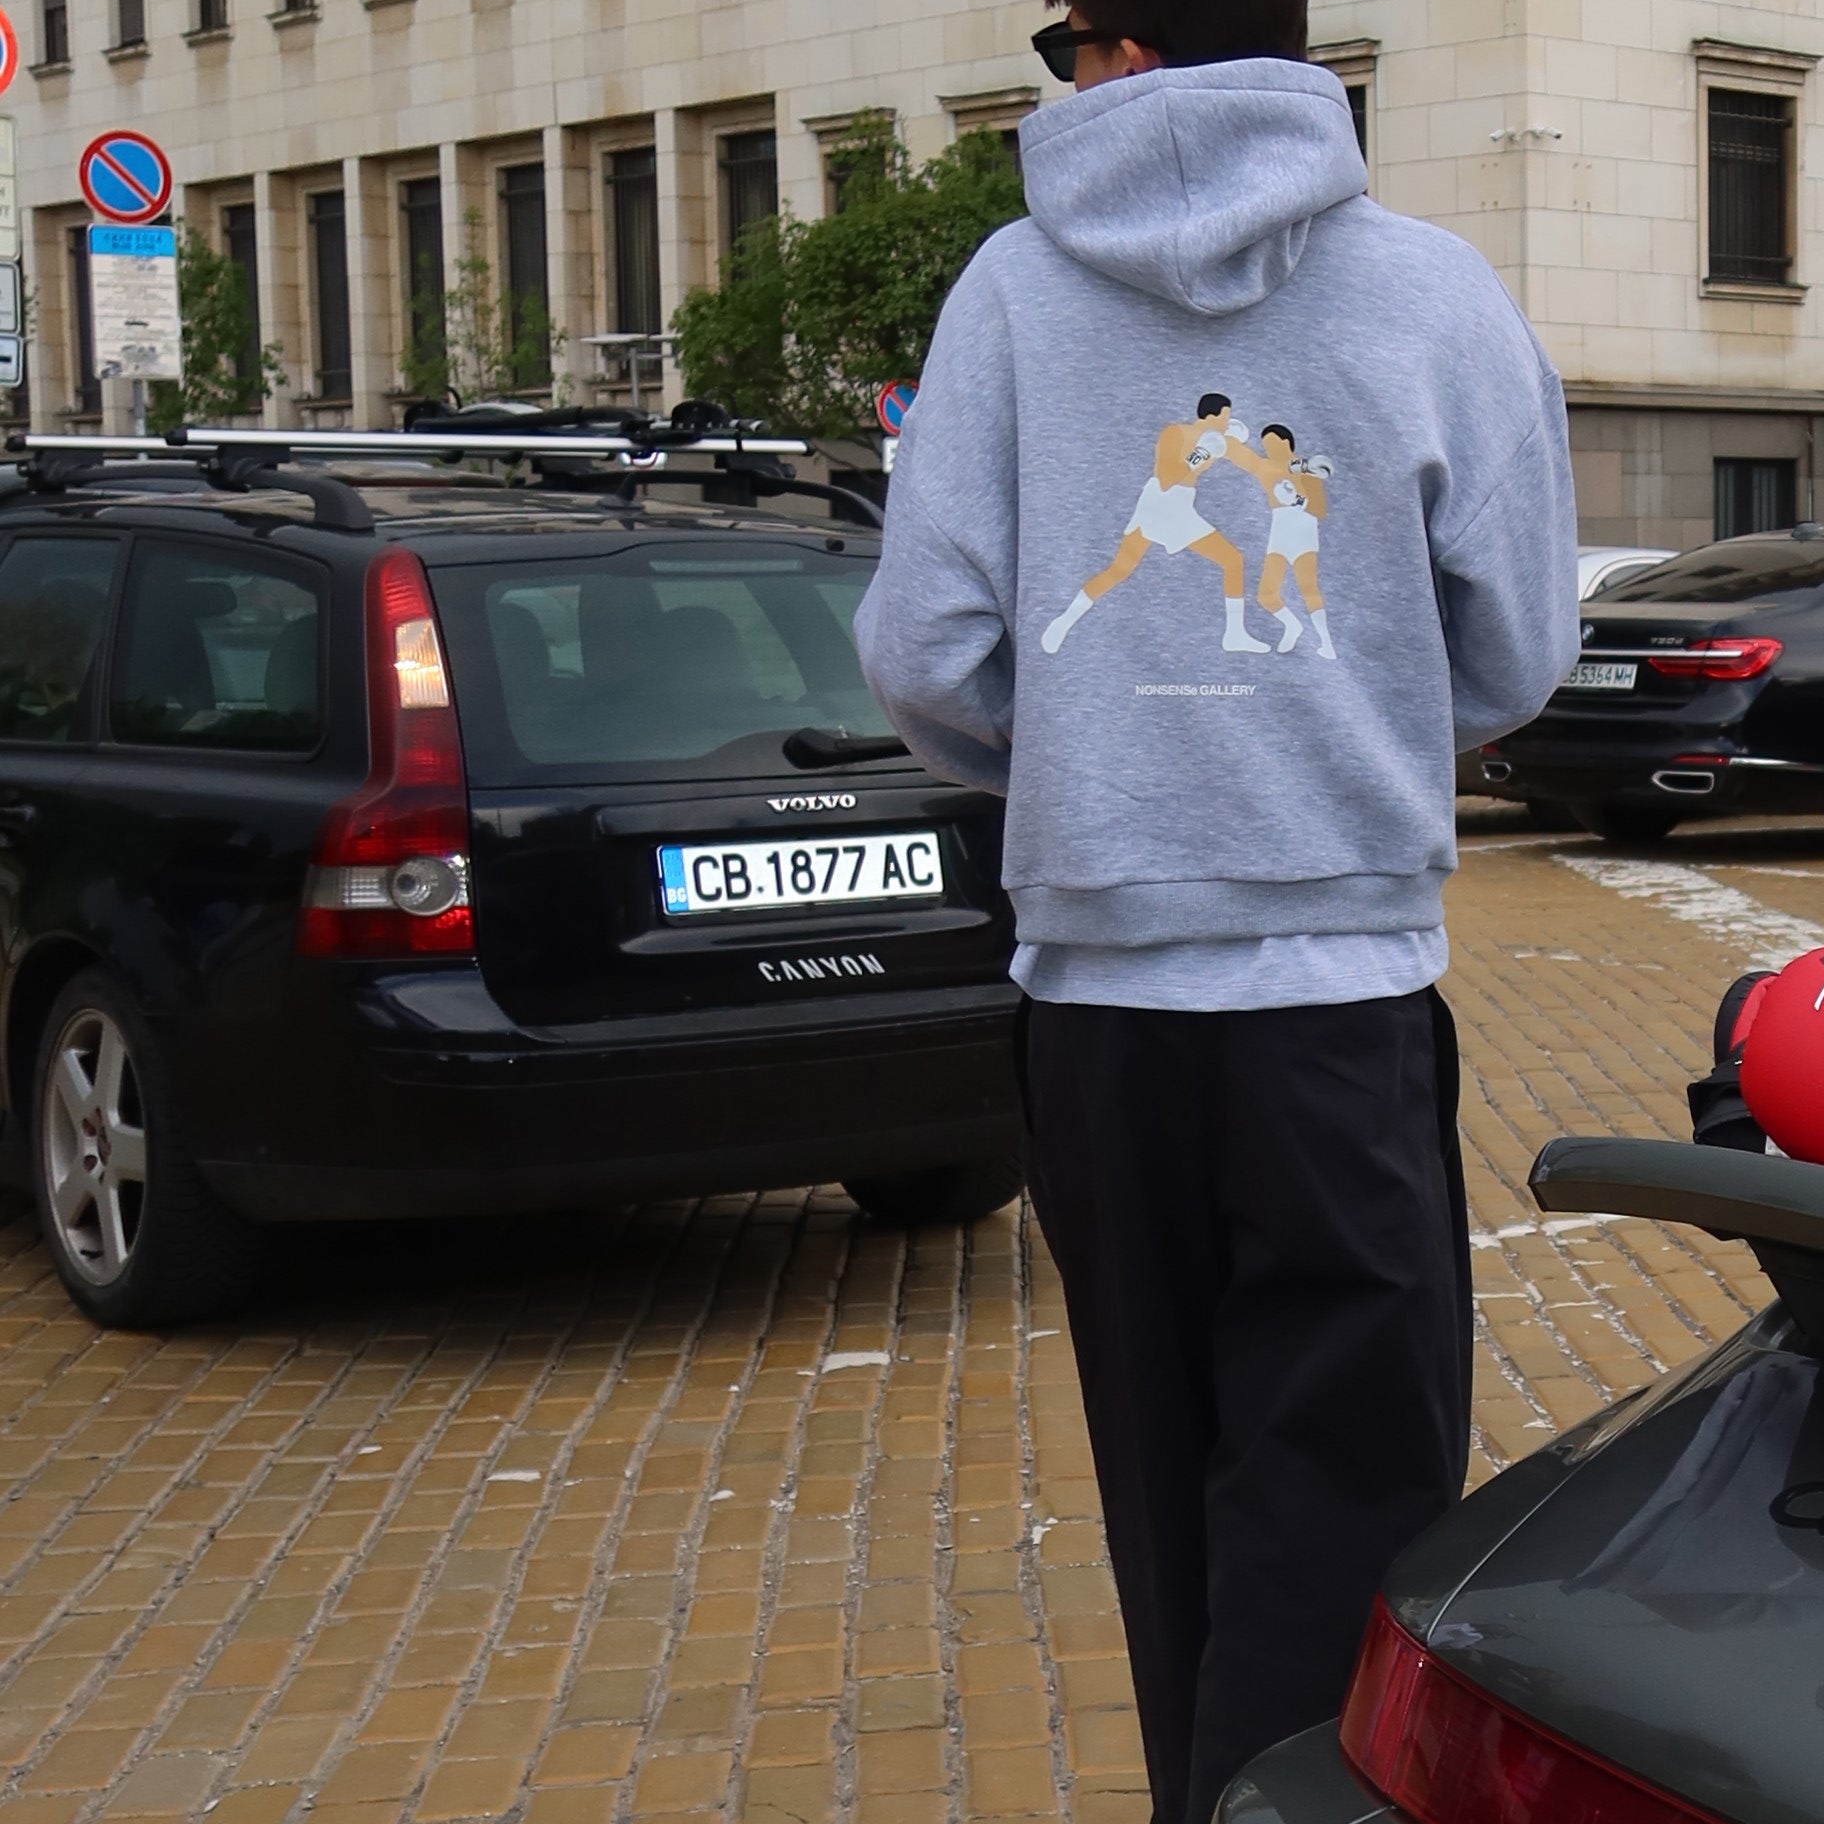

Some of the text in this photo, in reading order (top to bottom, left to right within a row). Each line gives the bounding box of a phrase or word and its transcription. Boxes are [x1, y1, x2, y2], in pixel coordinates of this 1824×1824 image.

[1200, 684, 1257, 696] GALLERY
[767, 794, 857, 813] VOLVO
[692, 842, 934, 902] CB 1877 AC
[667, 888, 687, 903] BG
[758, 953, 885, 982] CANYON
